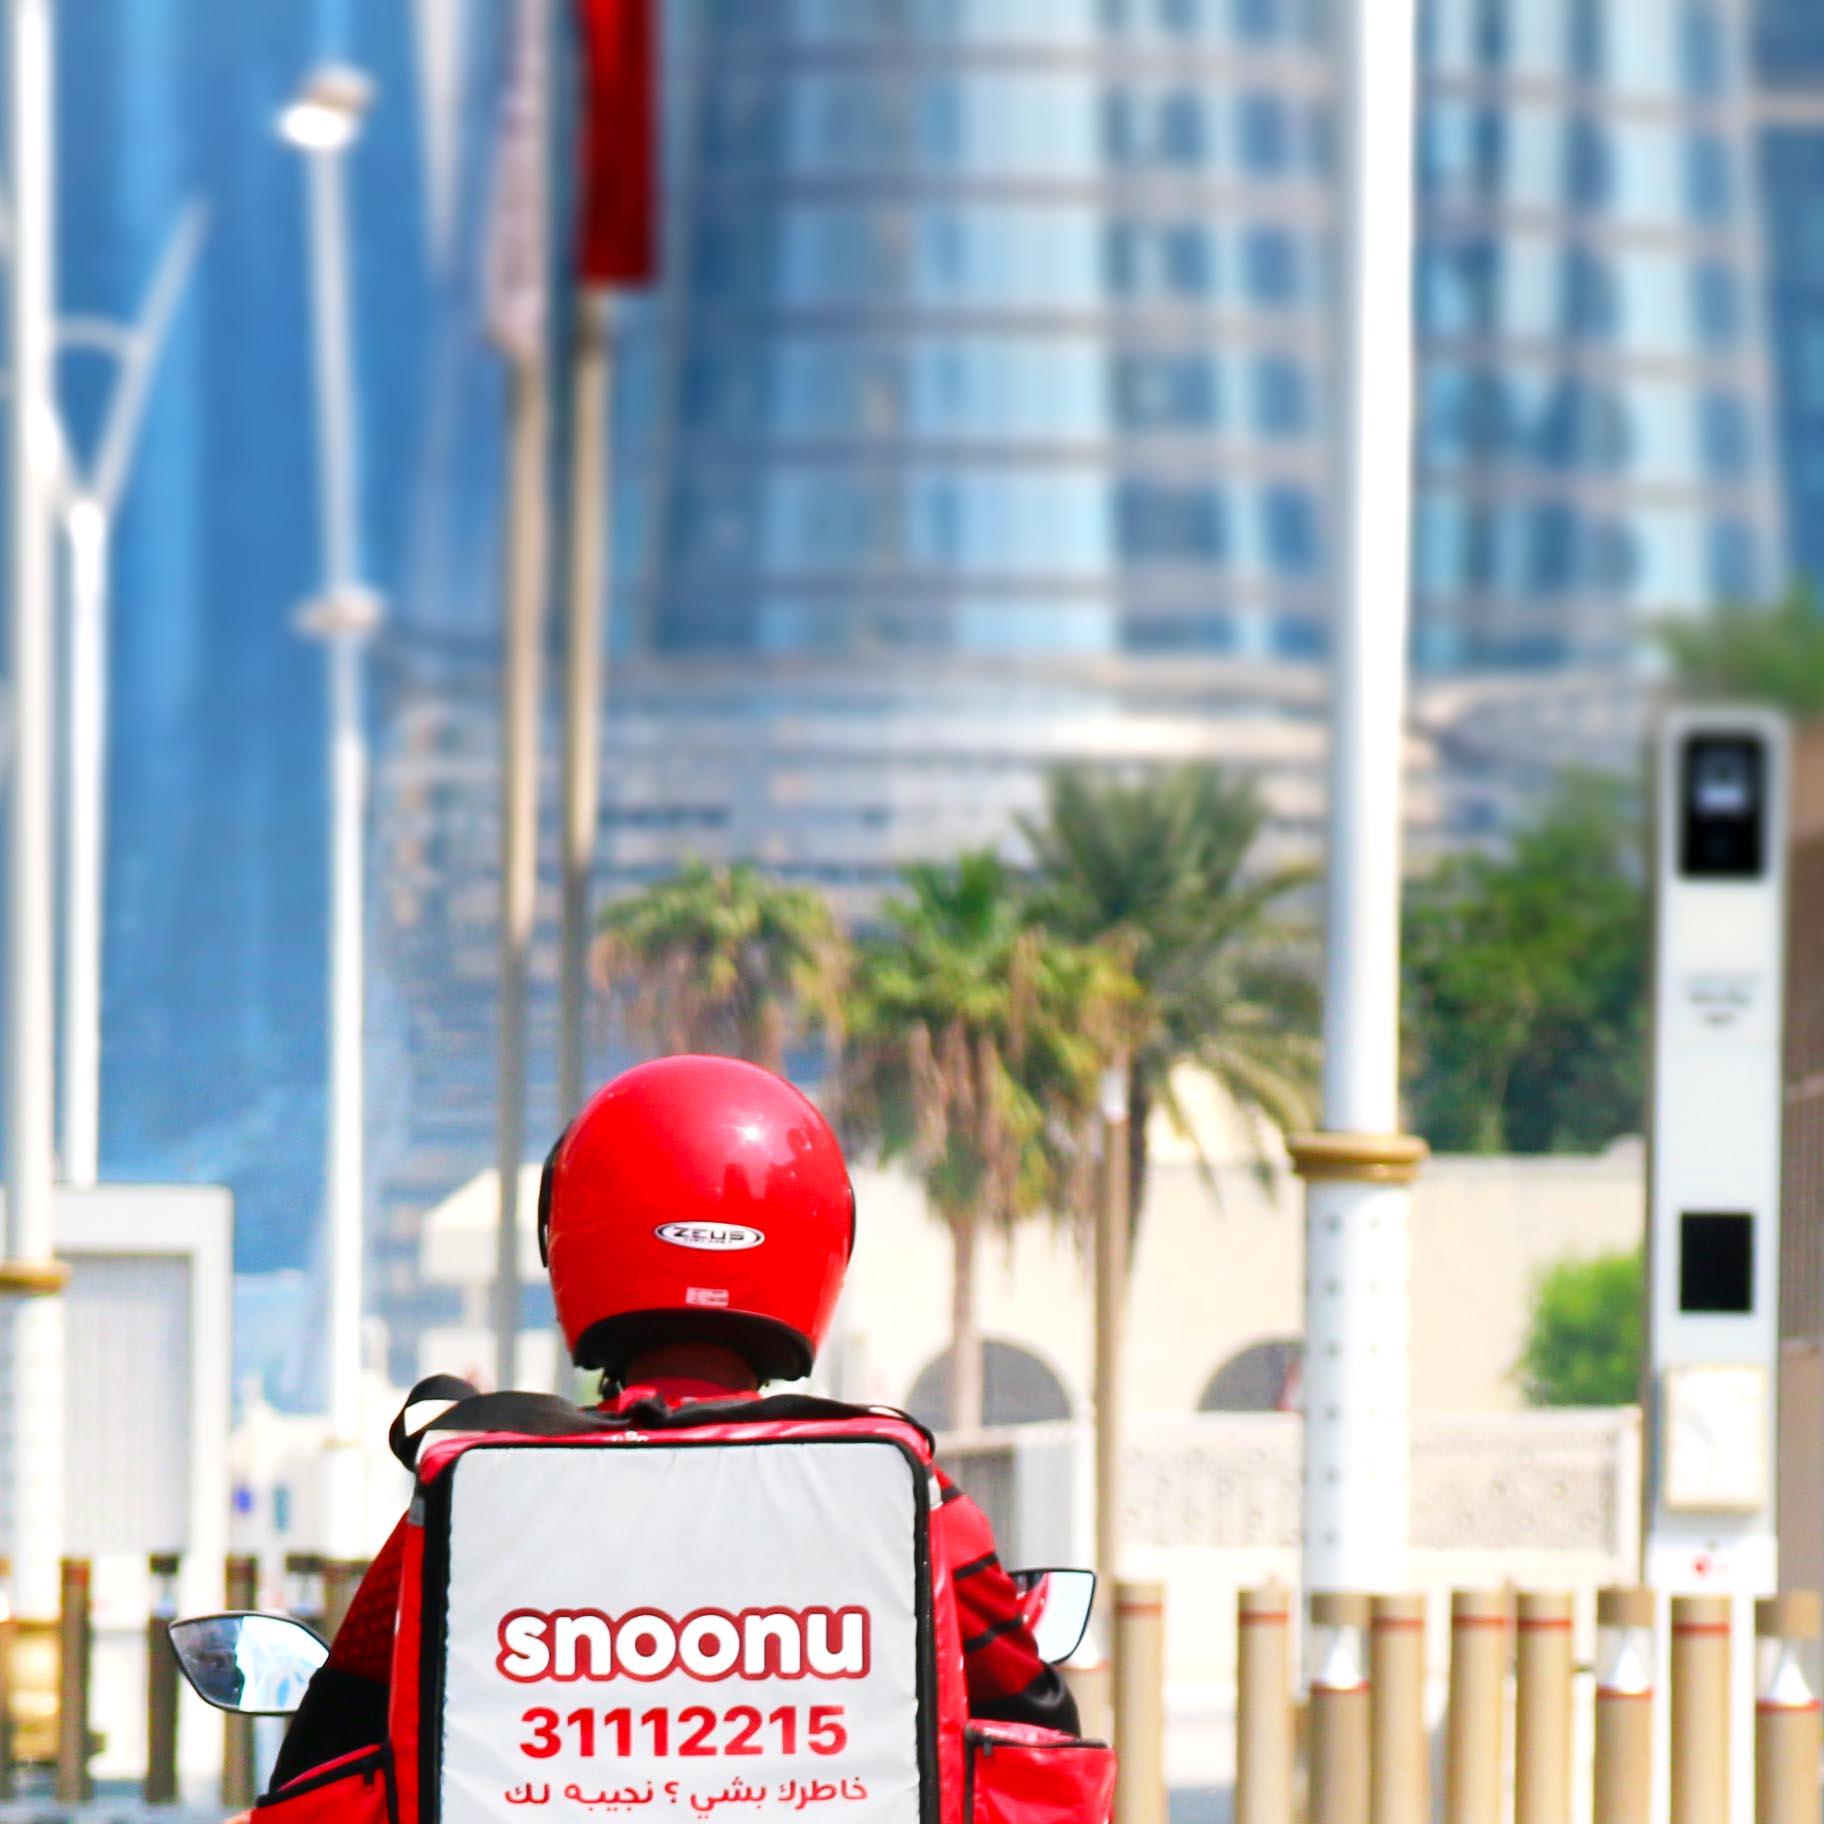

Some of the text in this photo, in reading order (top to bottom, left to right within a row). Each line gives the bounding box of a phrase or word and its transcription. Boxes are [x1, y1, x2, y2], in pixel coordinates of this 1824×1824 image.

[498, 1606, 868, 1682] snoonu
[519, 1704, 848, 1759] 31112215
[504, 1783, 551, 1805] لك
[690, 1777, 767, 1818] بشي
[778, 1777, 868, 1811] خاطرك
